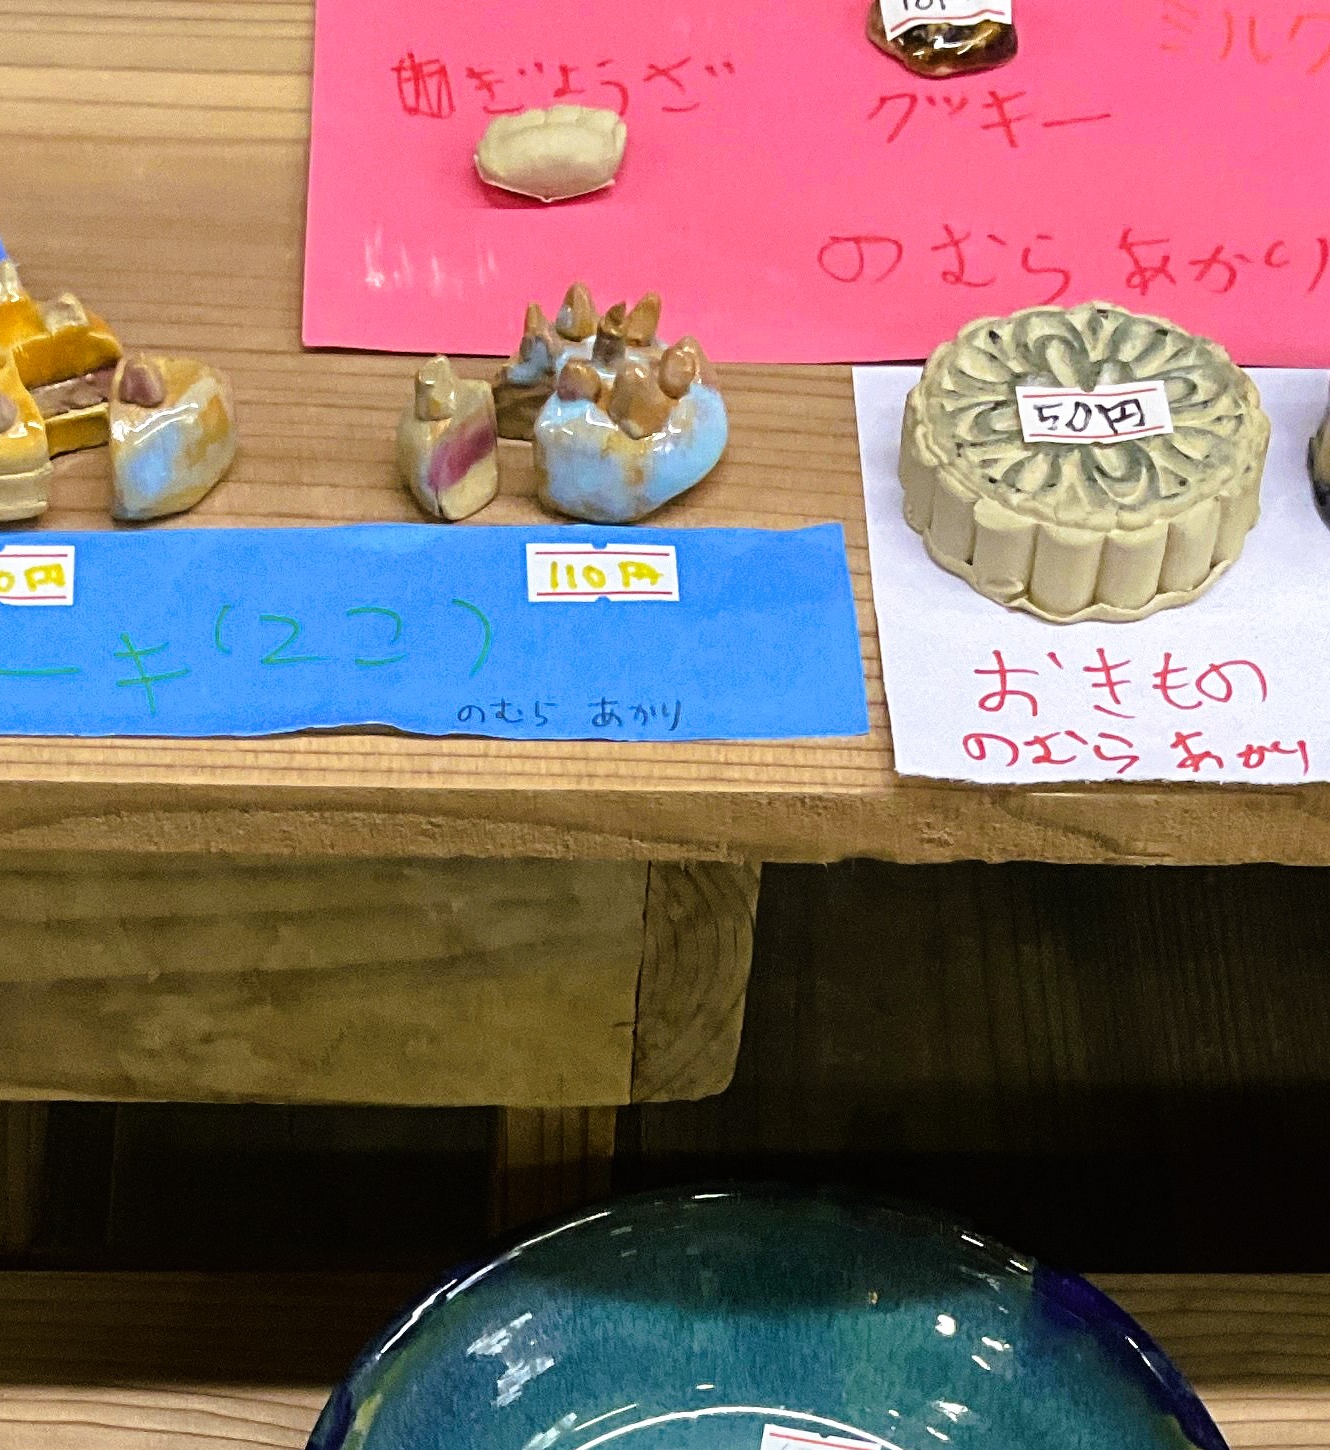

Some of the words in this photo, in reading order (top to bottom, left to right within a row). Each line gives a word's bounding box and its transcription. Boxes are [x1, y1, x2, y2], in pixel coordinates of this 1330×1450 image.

[869, 86, 1113, 150] クッキー
[817, 224, 1072, 303] のむら
[1120, 226, 1330, 299] あかり
[1031, 398, 1147, 434] 50円
[550, 560, 665, 590] 110円
[973, 648, 1266, 719] おきもの
[457, 698, 549, 728] のむら
[591, 696, 683, 733] あかり
[963, 731, 1140, 774] のむら
[1174, 729, 1309, 775] あかり
